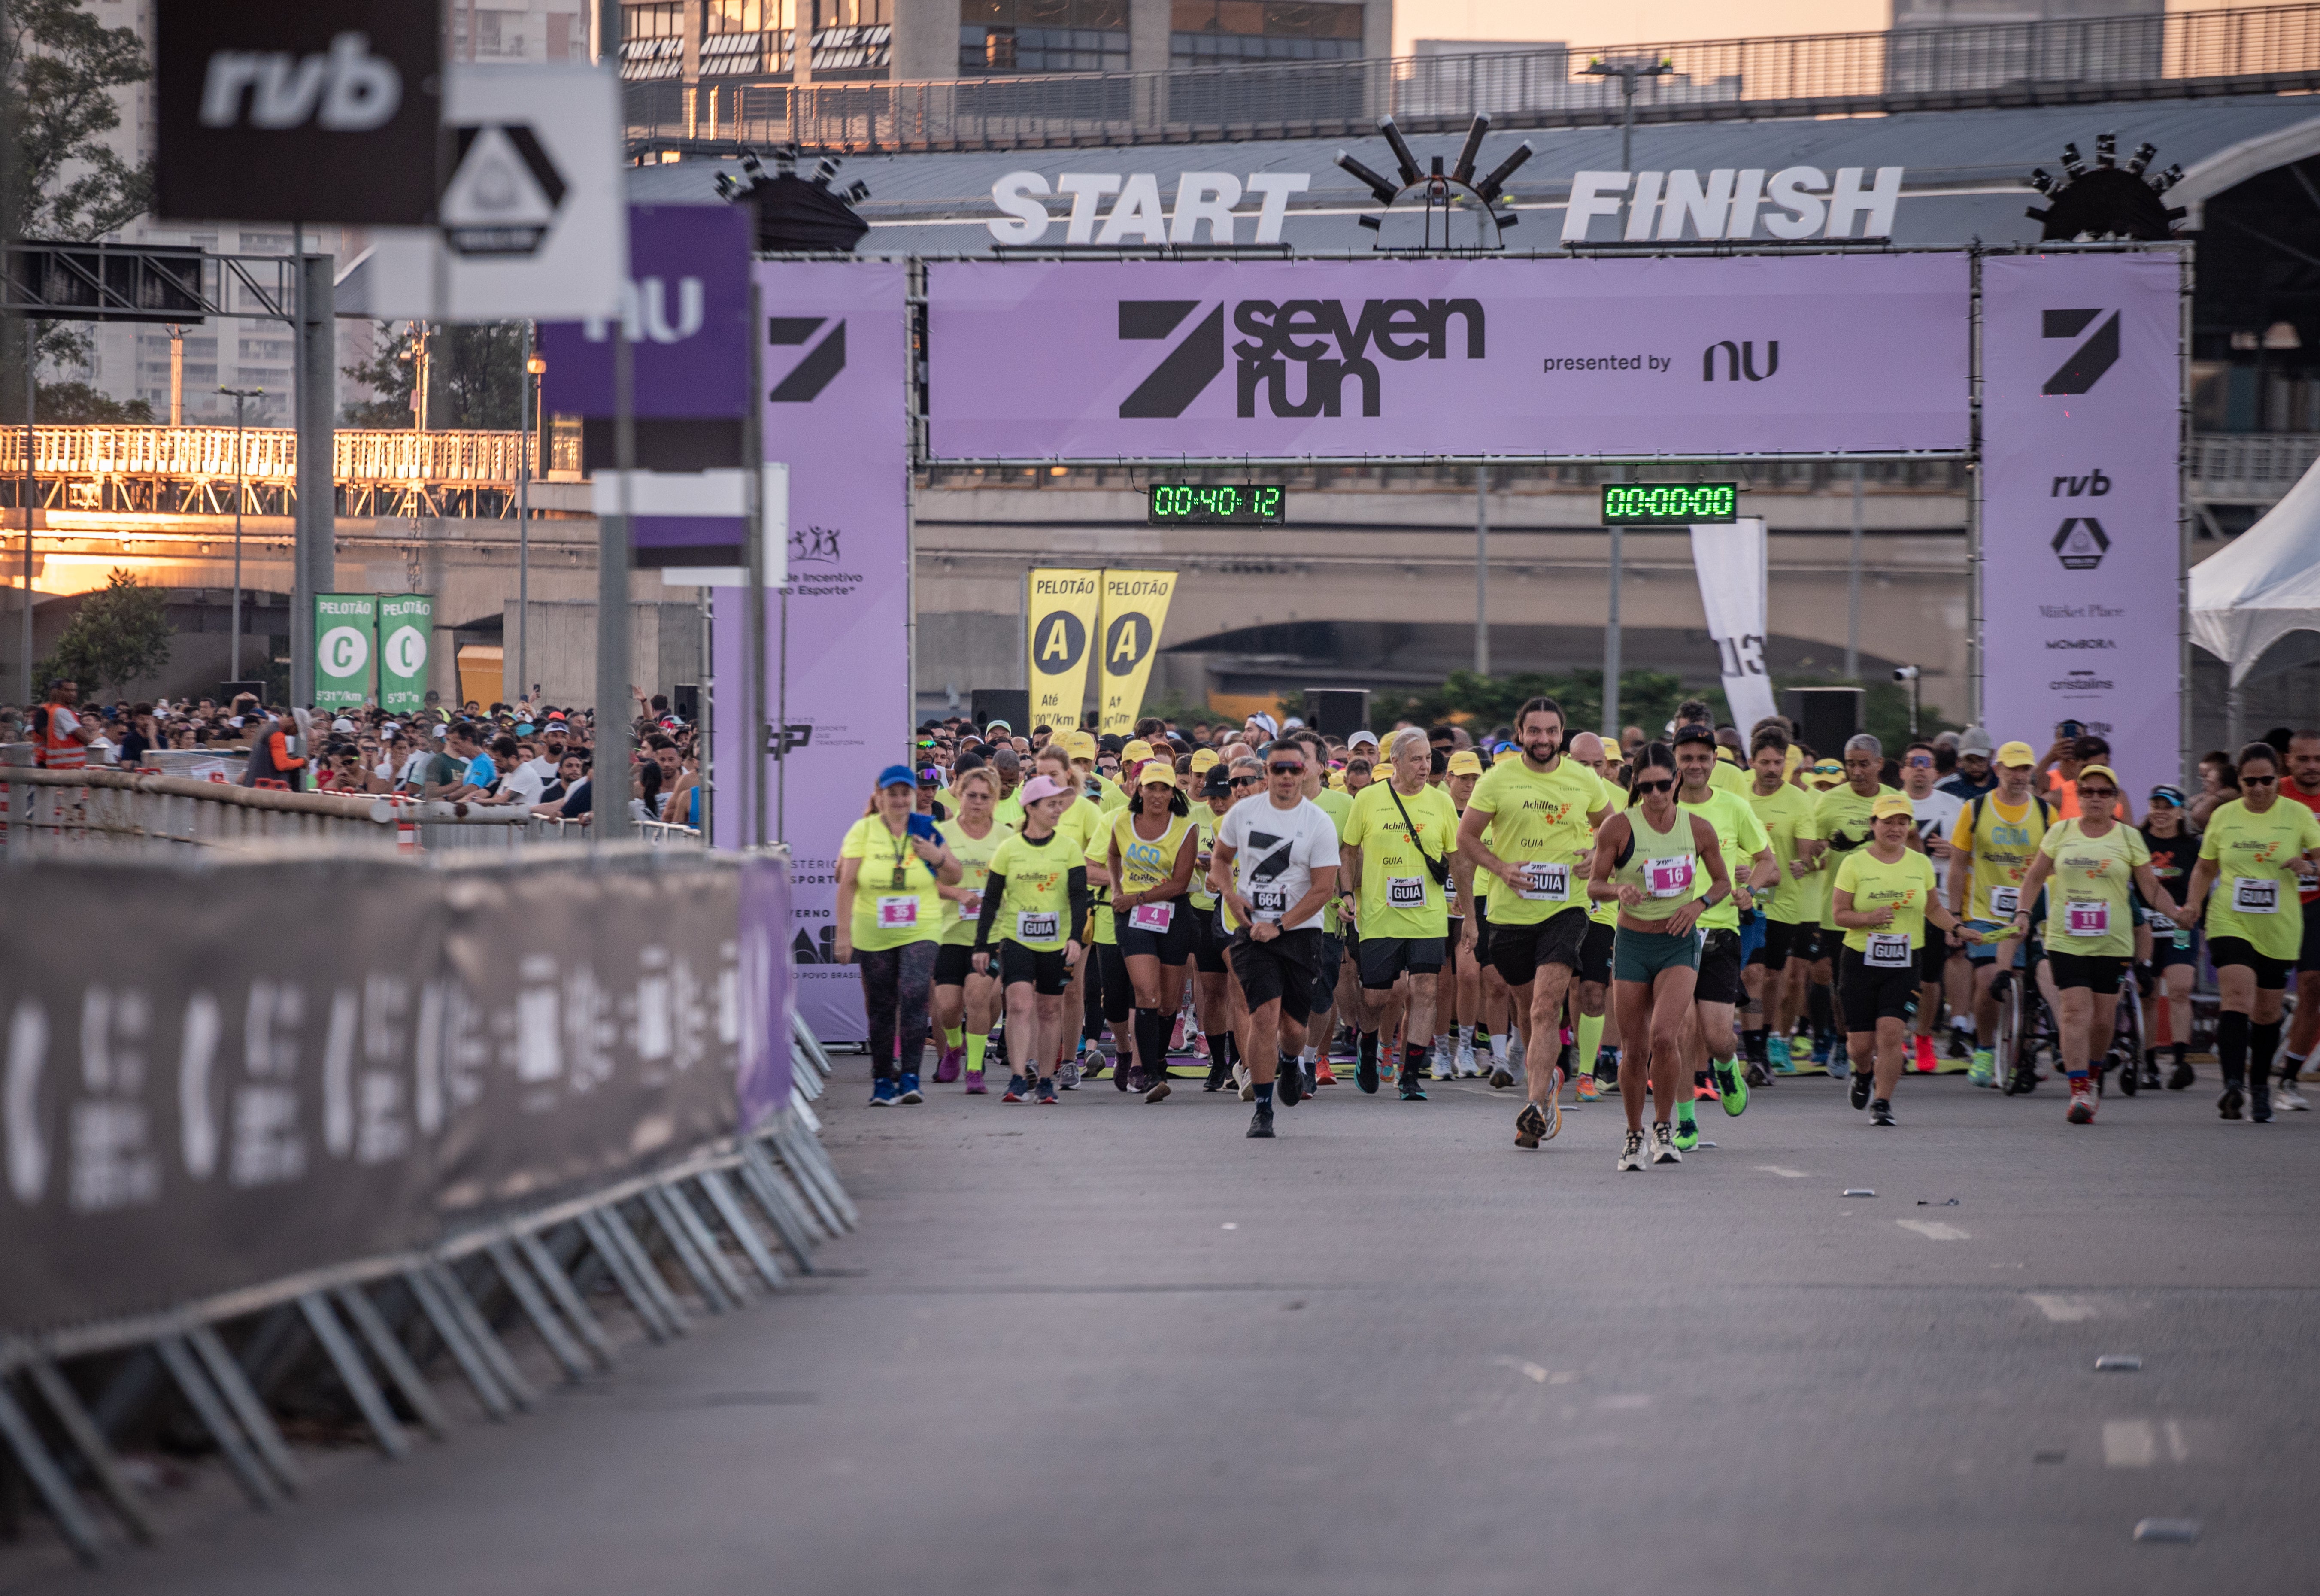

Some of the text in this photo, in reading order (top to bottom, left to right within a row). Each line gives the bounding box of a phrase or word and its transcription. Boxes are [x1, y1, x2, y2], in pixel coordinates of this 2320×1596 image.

[199, 31, 403, 130] rvb
[987, 171, 1310, 246] START
[1560, 166, 1905, 241] FINISH
[1232, 298, 1485, 362] seven
[1544, 355, 1671, 373] presented by
[1703, 340, 1779, 382] nu
[1237, 359, 1380, 418] run
[2050, 468, 2112, 497] rvb
[1606, 488, 1733, 516] 00:00:00
[803, 573, 863, 582] Incentivo
[1037, 578, 1094, 595] PELOTÃO
[1108, 580, 1168, 596] PELOTÃO
[320, 601, 371, 615] PELOTÃO
[383, 601, 431, 616] PELOTÃO
[1042, 619, 1068, 661] A
[1112, 620, 1137, 663] A
[332, 636, 352, 668] C
[1041, 693, 1058, 707] Até
[1108, 696, 1122, 708] At
[1522, 800, 1559, 812] Achilles
[1992, 826, 2031, 846] GUIA
[1521, 839, 1543, 848] GUIA
[1126, 843, 1161, 865] ACD
[1383, 857, 1403, 865] GUIA
[791, 858, 837, 868] STÉRIO
[791, 876, 834, 884] SPORT
[1016, 872, 1048, 880] Achilles
[1666, 868, 1684, 883] 16
[1394, 886, 1421, 899] GUIA
[1867, 891, 1905, 900] Achilles
[1258, 893, 1281, 907] 664
[790, 910, 830, 918] ERNO
[893, 906, 910, 918] 35
[1150, 909, 1158, 920] 4
[2081, 912, 2097, 924] 11
[1025, 922, 1053, 934] GUIA
[1874, 944, 1906, 958] GUIA
